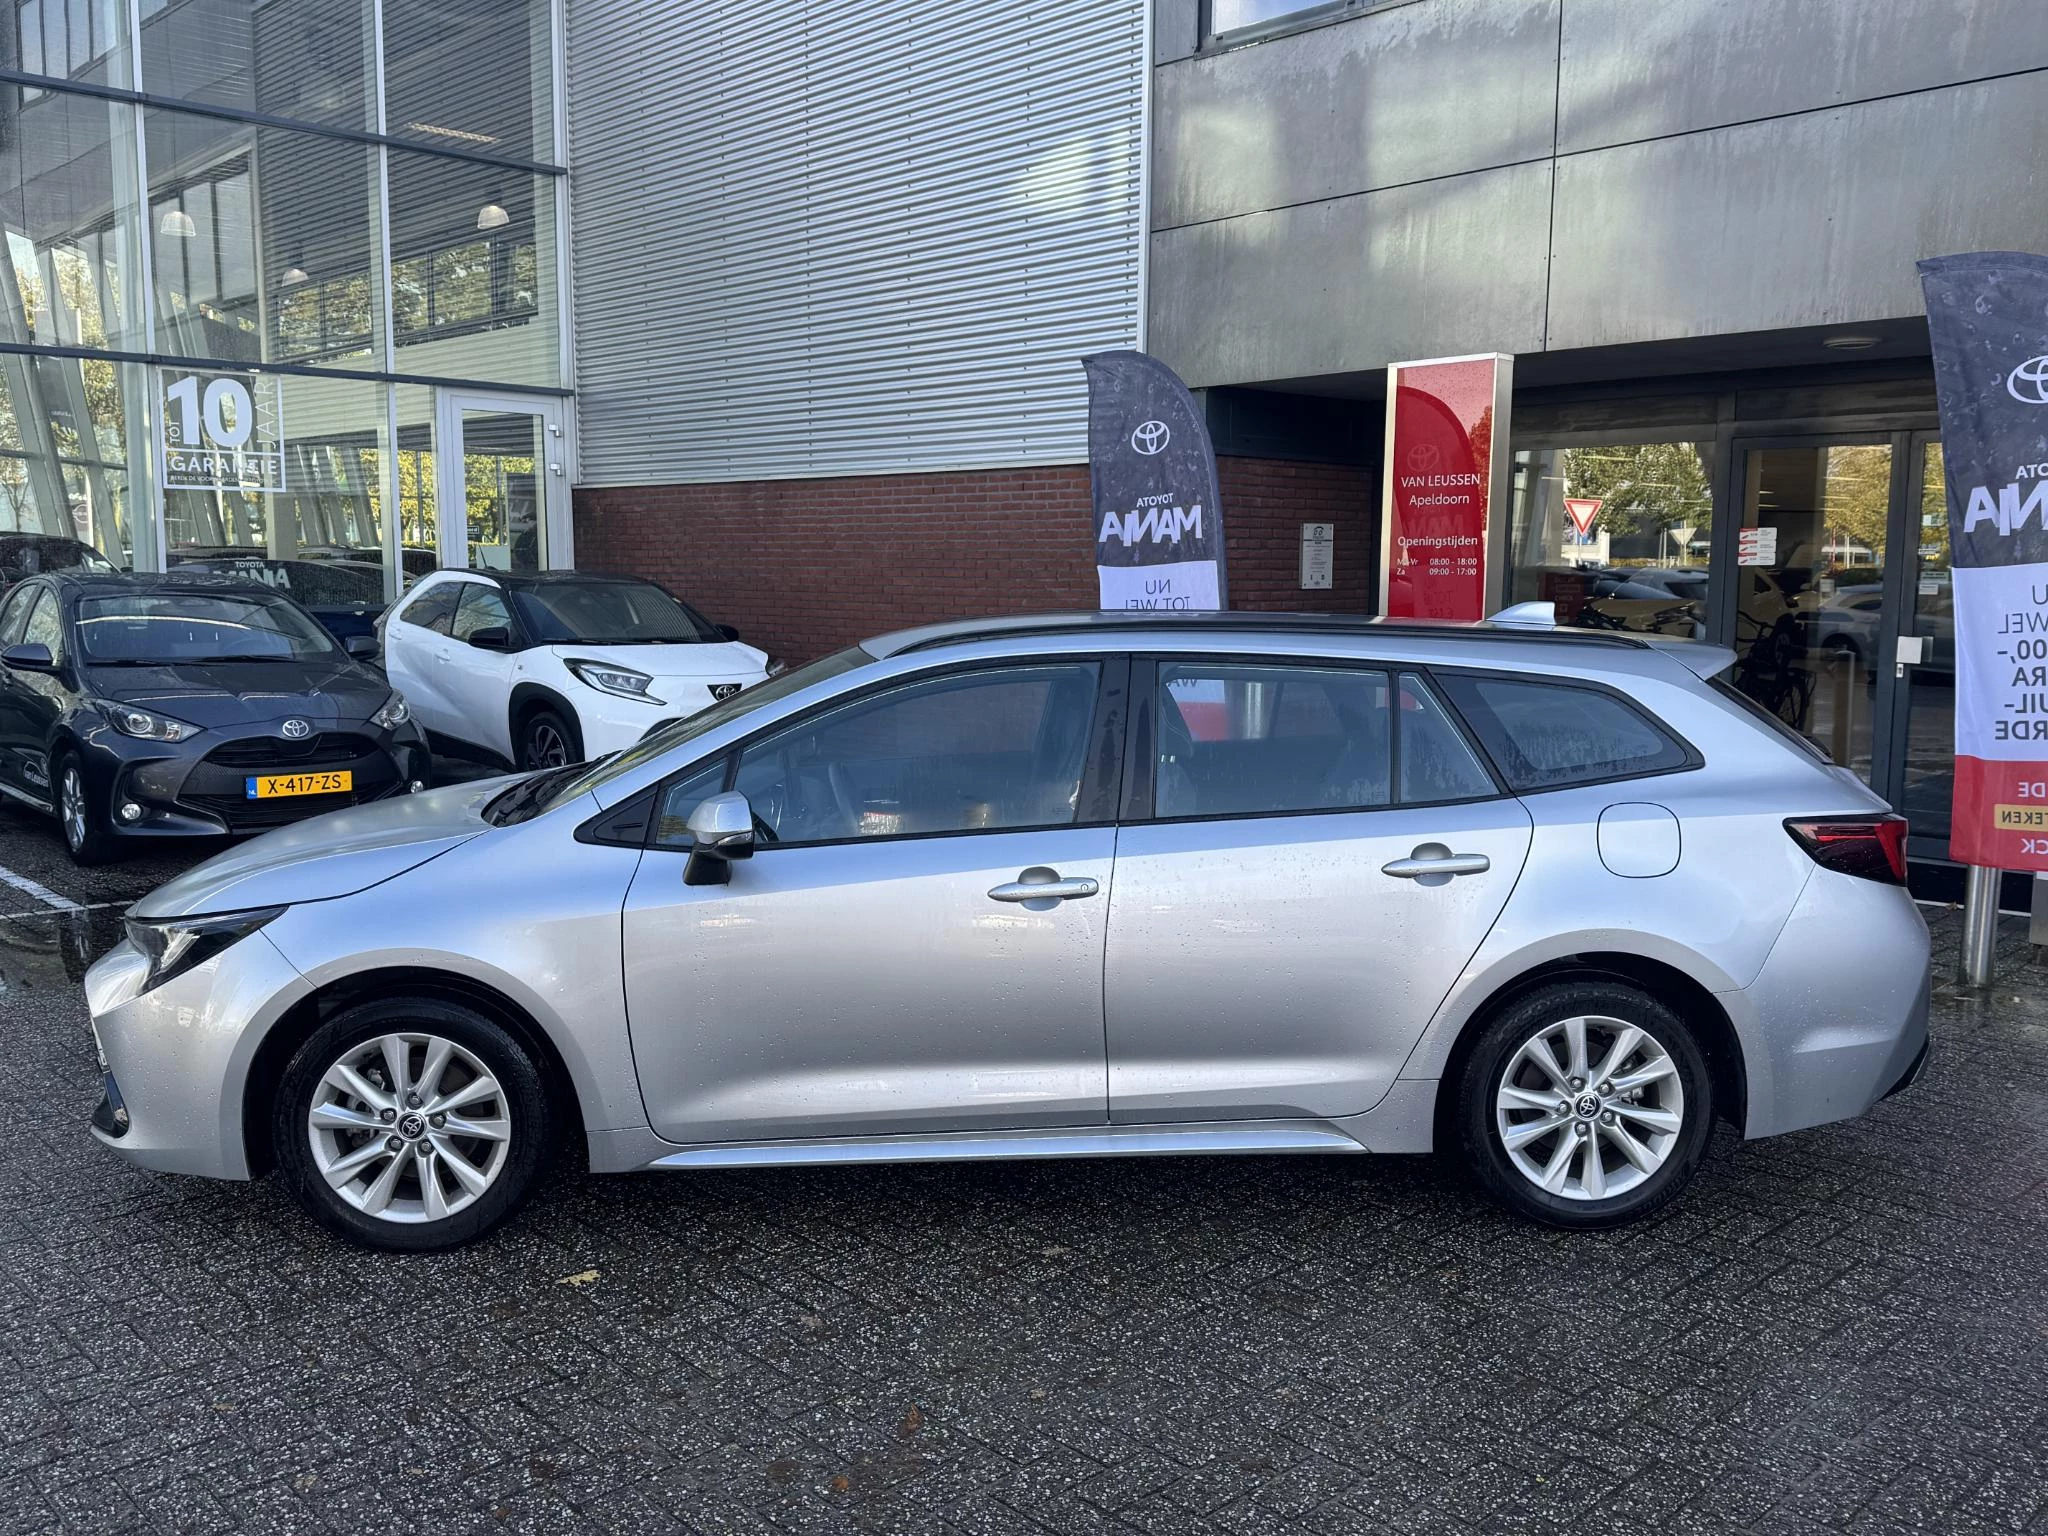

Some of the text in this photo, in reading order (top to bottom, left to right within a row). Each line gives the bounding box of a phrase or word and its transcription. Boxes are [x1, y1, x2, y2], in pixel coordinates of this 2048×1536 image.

[167, 376, 252, 447] 10
[254, 382, 276, 449] JAAR
[169, 420, 180, 443] TOT
[1401, 473, 1480, 487] VAN LEUSSEN
[1409, 494, 1470, 507] Apeldoorn
[1397, 536, 1478, 548] Openingstijden
[268, 774, 342, 794] X-417-ZS
